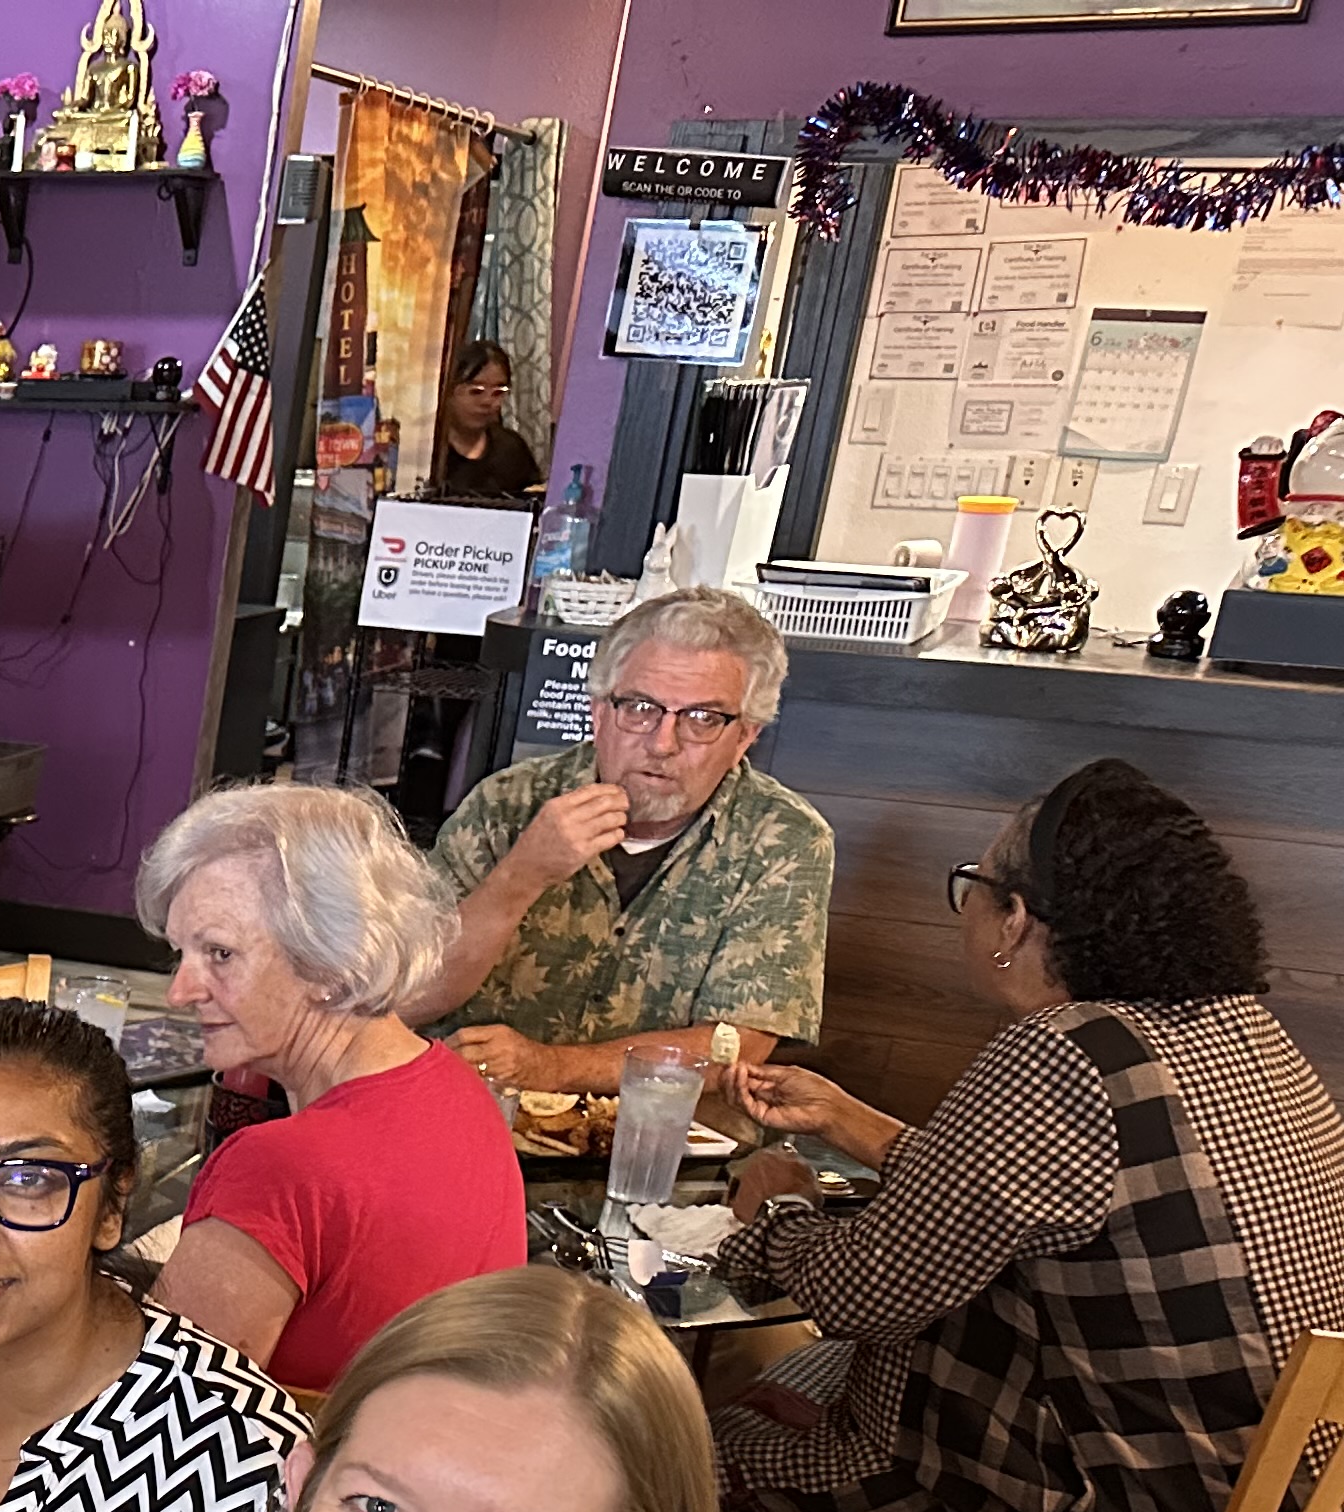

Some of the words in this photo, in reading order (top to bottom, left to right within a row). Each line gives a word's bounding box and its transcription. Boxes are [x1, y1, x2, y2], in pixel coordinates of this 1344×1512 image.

[607, 152, 768, 181] WELCOME
[622, 180, 652, 193] SCAN
[654, 182, 675, 195] THE
[694, 186, 724, 200] CODE
[727, 189, 742, 201] TO
[338, 253, 357, 386] HOTEL
[1090, 331, 1103, 346] 6
[415, 541, 461, 558] Order
[463, 545, 513, 566] Pickup
[413, 557, 456, 571] PICKUP
[458, 561, 490, 574] ZONE
[372, 589, 397, 601] Uber
[542, 638, 597, 659] Food
[539, 688, 564, 700] food
[544, 679, 580, 691] Please
